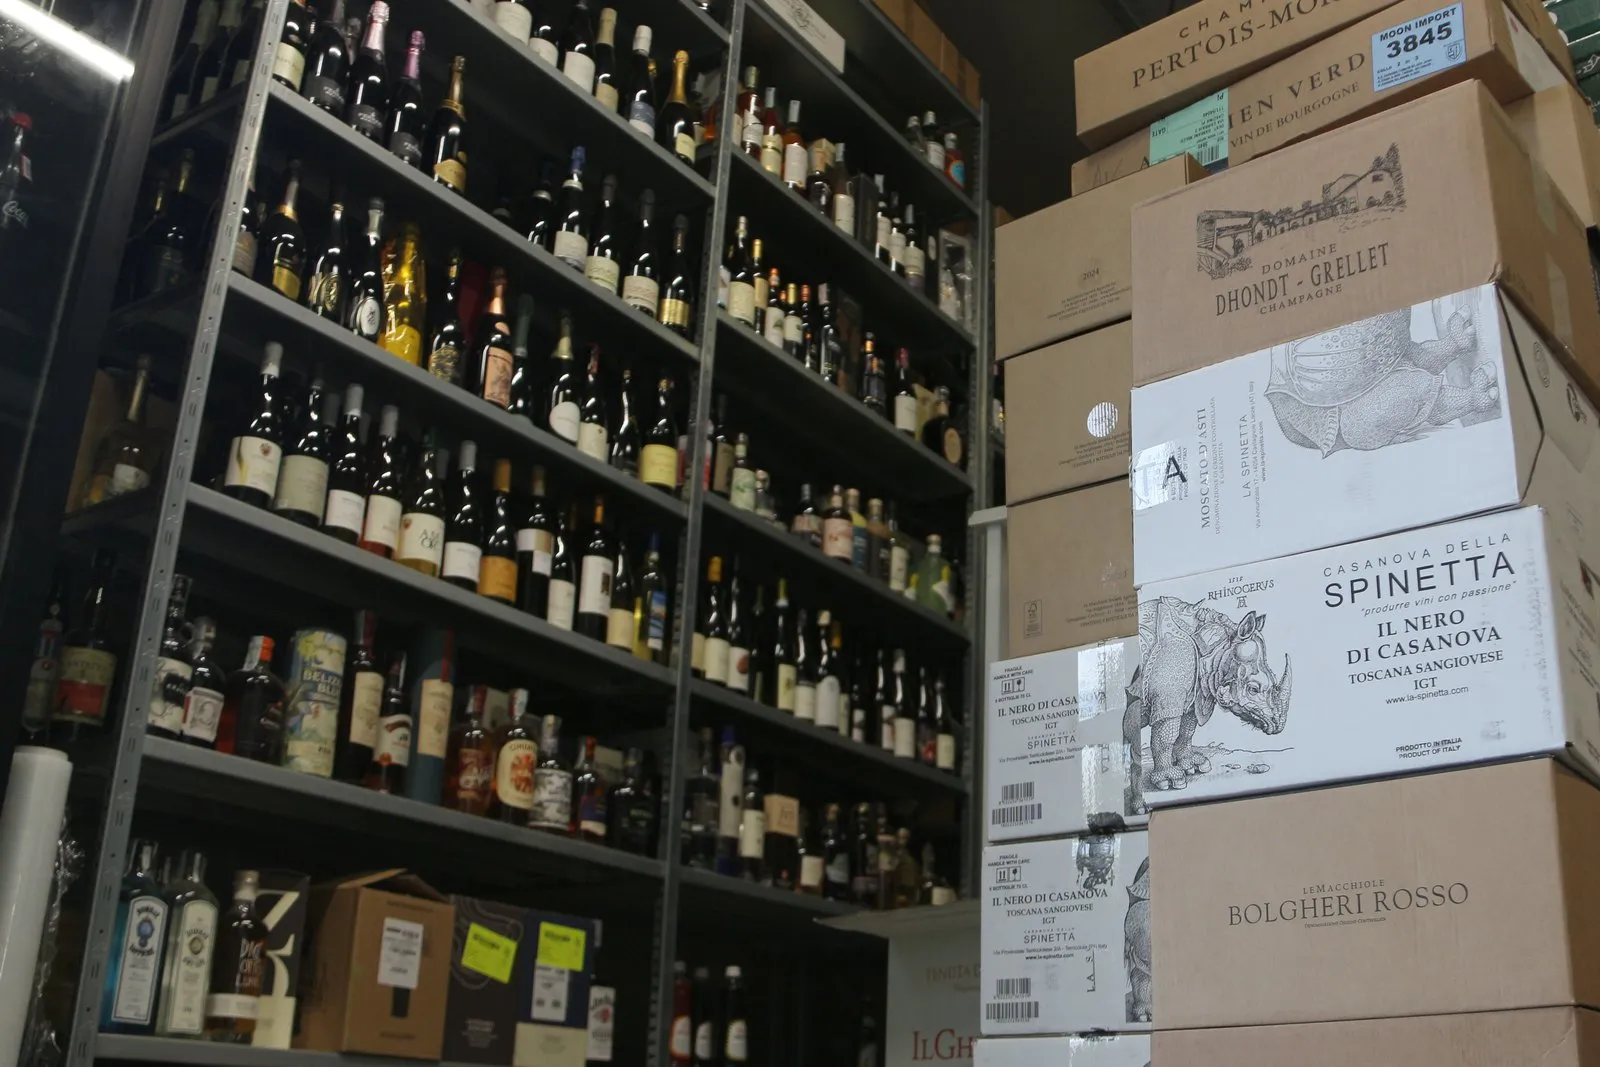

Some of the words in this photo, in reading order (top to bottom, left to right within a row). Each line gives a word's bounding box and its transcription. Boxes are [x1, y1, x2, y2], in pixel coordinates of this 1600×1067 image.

[1179, 0, 1265, 38] CHAM
[1380, 24, 1412, 41] MOON
[1415, 8, 1456, 29] IMPORT
[1386, 22, 1452, 58] 3845
[1287, 52, 1365, 99] VERD
[1230, 132, 1254, 148] VIN
[1256, 122, 1273, 138] DE
[1276, 82, 1359, 127] BOURGOGNE
[1261, 243, 1337, 275] DOMAINE
[1215, 273, 1289, 316] DHONDT
[1310, 242, 1389, 287] GRELLET
[1259, 284, 1343, 315] CHAMPAGNE
[1197, 407, 1208, 457] D'ASTI
[1239, 414, 1250, 477] SPINETTA
[1199, 459, 1210, 529] MOSCATO
[1242, 480, 1251, 498] LA
[1323, 548, 1431, 577] CASANOVA
[1446, 532, 1511, 554] DELLA
[1324, 551, 1516, 608] SPINETTA
[1414, 596, 1434, 607] vini
[1437, 593, 1457, 603] con
[1377, 621, 1397, 638] IL
[1404, 609, 1465, 633] NERO
[1347, 647, 1370, 665] DI
[1377, 626, 1502, 660] CASANOVA
[1348, 665, 1413, 684] TOSCANA
[1415, 650, 1504, 674] SANGIOVESE
[1385, 685, 1469, 705] www.la-spinetta.com
[1414, 676, 1438, 690] IGT
[997, 707, 1007, 717] IL
[1008, 703, 1036, 717] NERO
[1038, 699, 1050, 711] DI
[1011, 714, 1046, 726] TOSCANA
[1045, 722, 1058, 730] IGT
[1027, 735, 1076, 750] SPINETTA
[1395, 741, 1432, 752] PRODOTTO
[1433, 739, 1440, 748] IN
[1440, 737, 1463, 747] ITALIA
[1399, 748, 1430, 759] PRODUCT
[1431, 747, 1440, 756] OF
[1441, 745, 1461, 754] ITALY
[992, 897, 1002, 907] IL
[1003, 895, 1032, 906] NERO
[1035, 892, 1047, 903] DI
[1048, 888, 1108, 902] CASANOVA
[1006, 907, 1043, 917] TOSCANA
[1043, 903, 1094, 915] SANGIOVESE
[1228, 892, 1363, 926] BOLGHERI
[1374, 882, 1469, 913] ROSSO
[1042, 916, 1056, 924] IGT
[1023, 932, 1076, 944] SPINETTA
